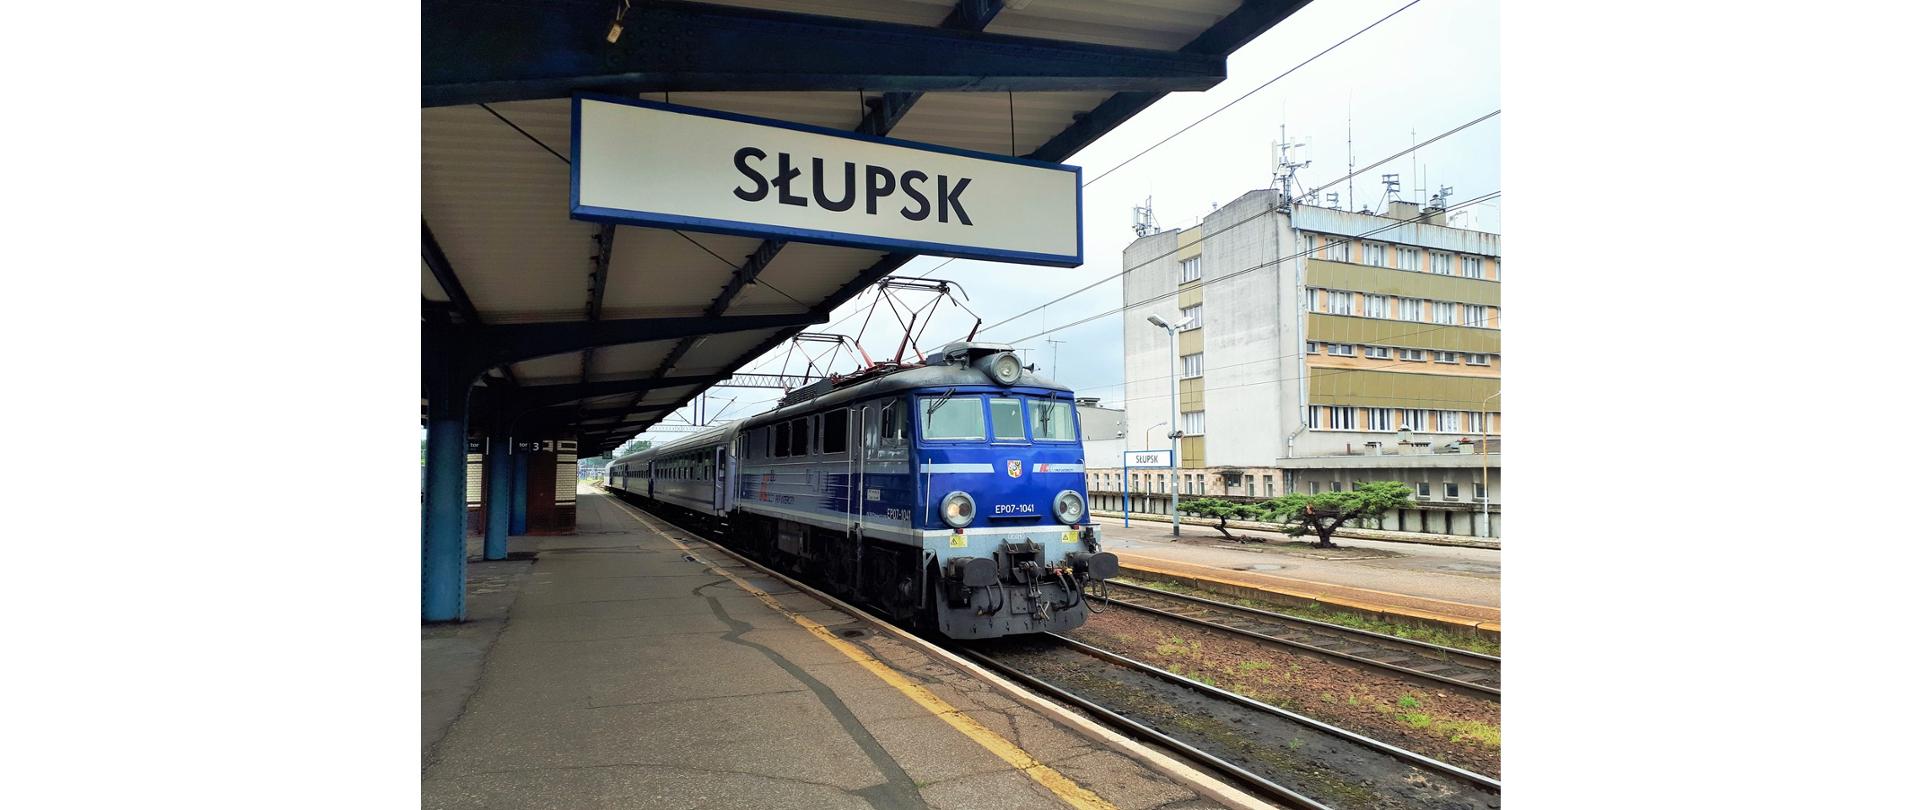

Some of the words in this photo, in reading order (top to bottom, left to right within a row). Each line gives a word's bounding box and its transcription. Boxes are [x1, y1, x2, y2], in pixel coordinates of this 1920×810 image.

[732, 146, 973, 226] SŁUPSK
[532, 442, 540, 451] 3
[1135, 455, 1159, 464] SŁUPSK
[995, 504, 1035, 514] EP07-1041
